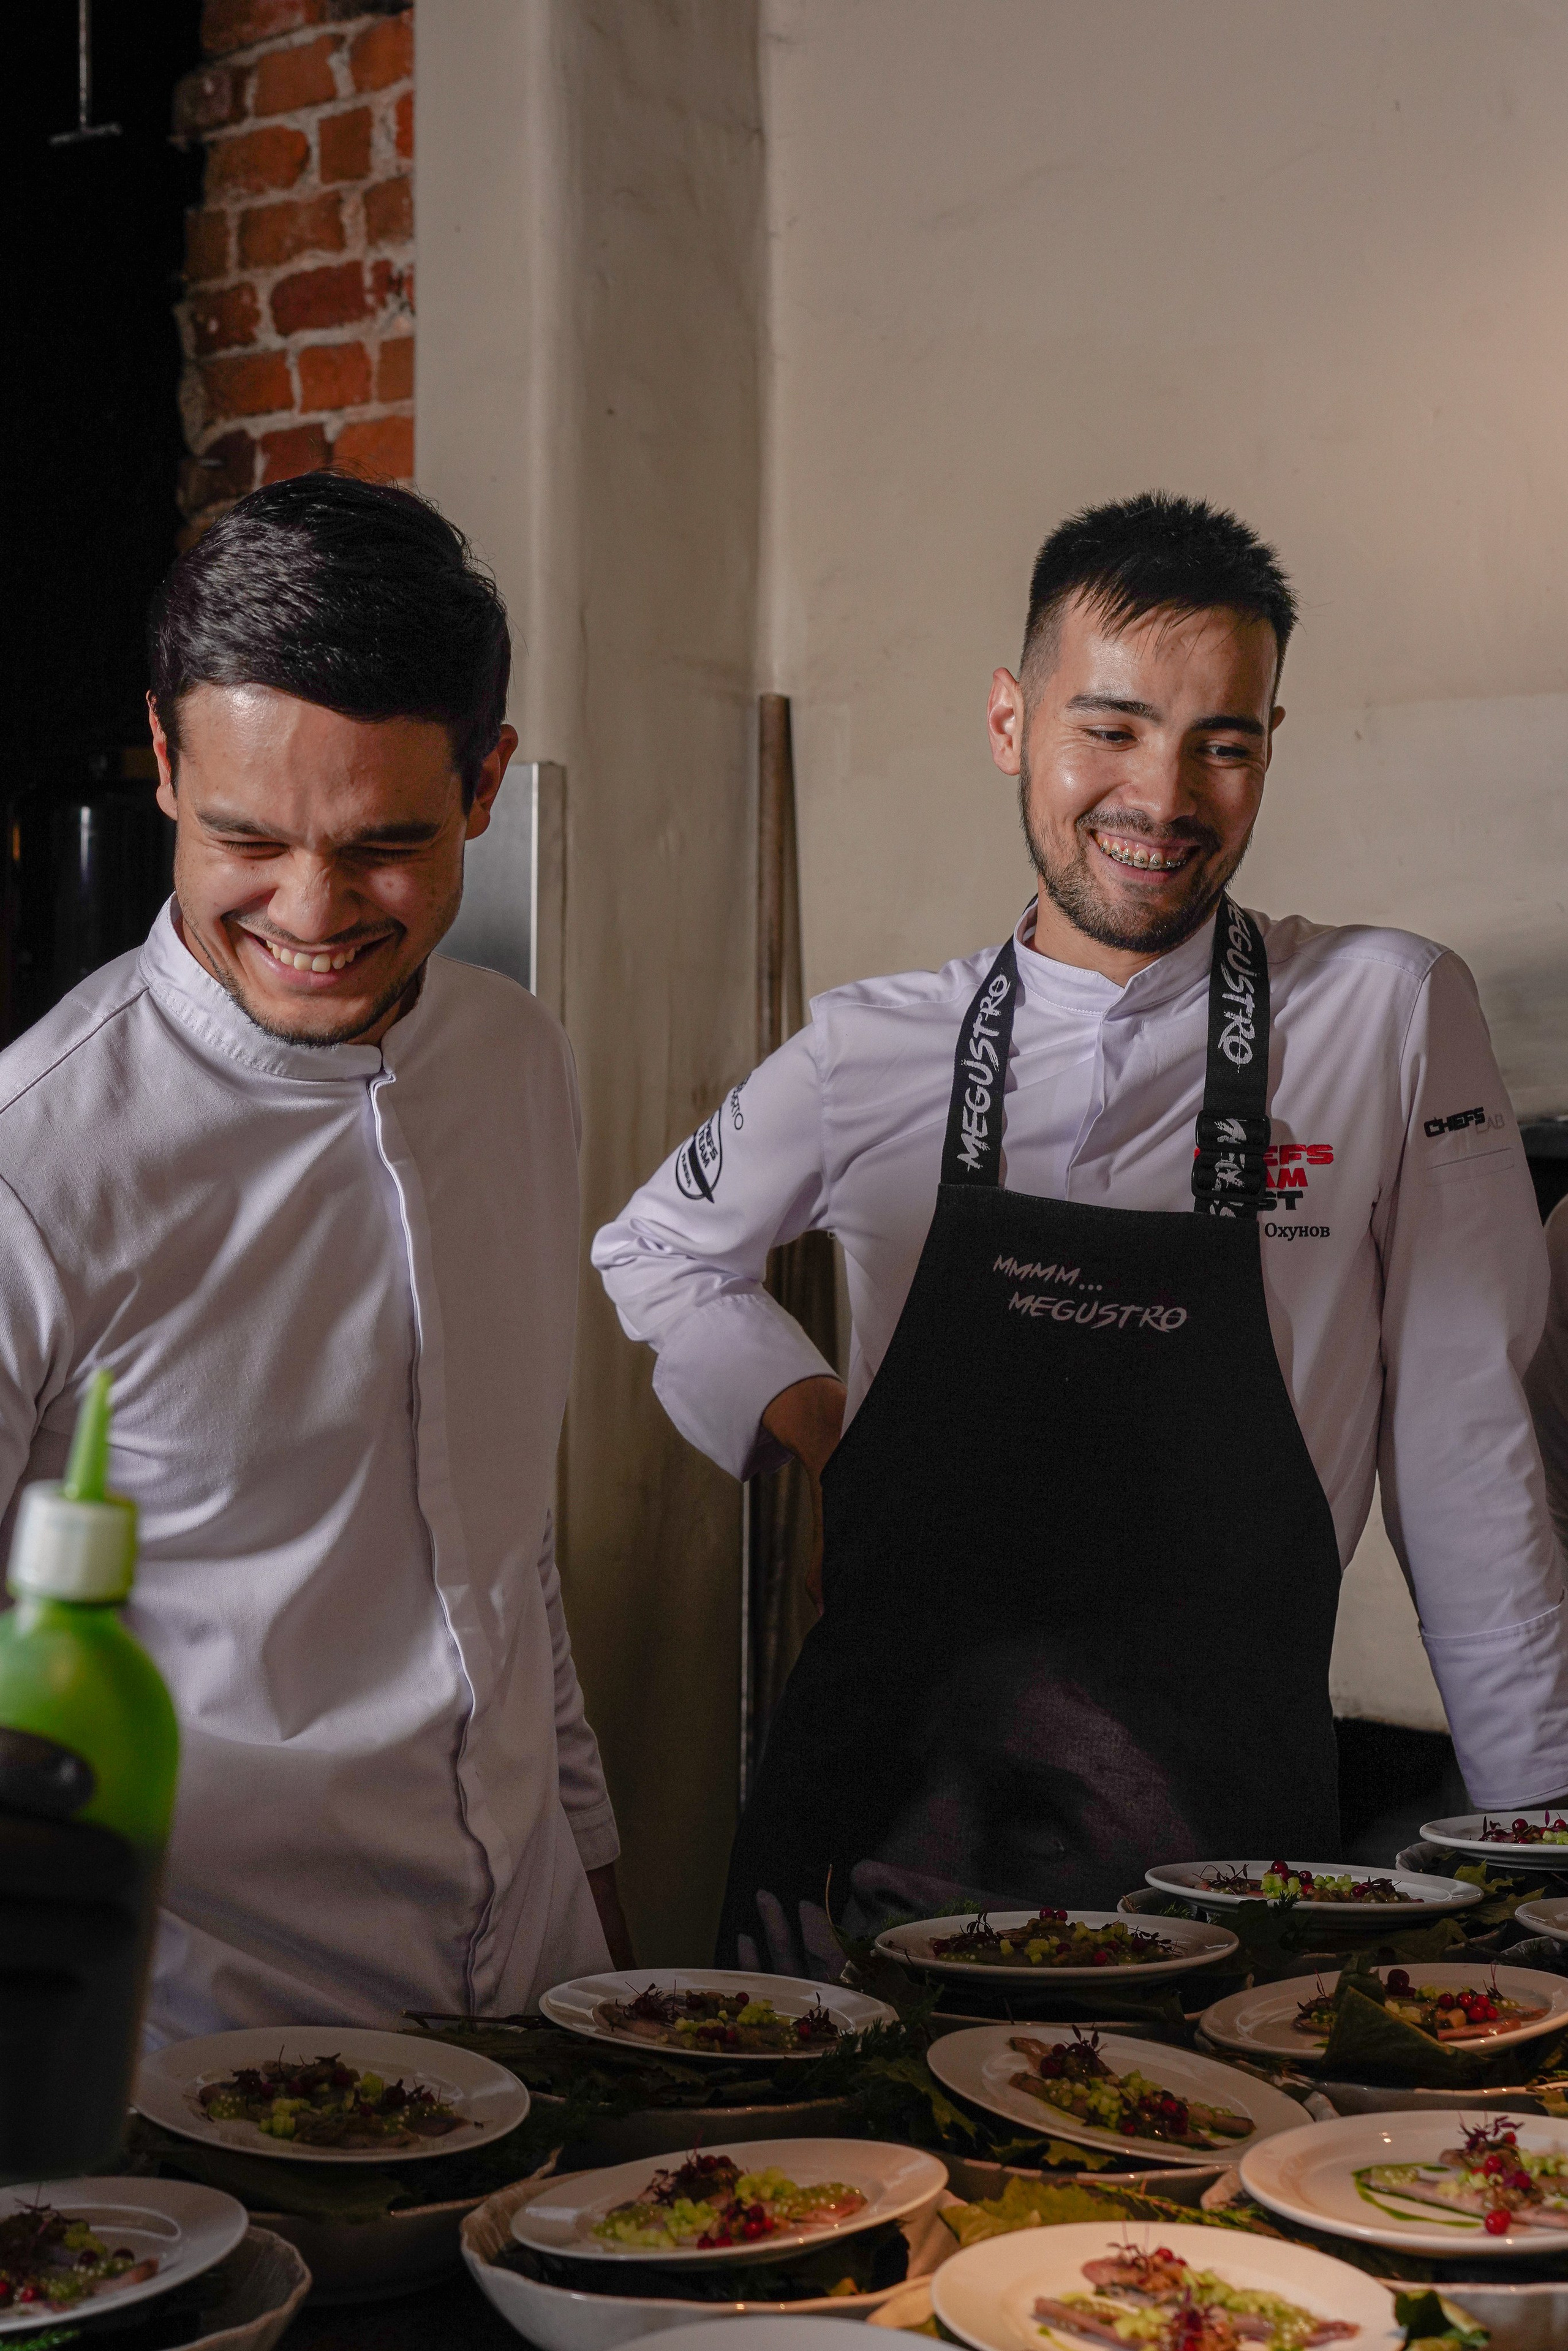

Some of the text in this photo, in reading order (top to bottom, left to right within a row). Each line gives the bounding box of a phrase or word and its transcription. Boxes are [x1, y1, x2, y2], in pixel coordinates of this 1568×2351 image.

[957, 974, 1011, 1172] MEGUSTRO
[1423, 1106, 1485, 1138] CHEFS
[1263, 1144, 1333, 1166] EFS
[1264, 1223, 1330, 1241] Охунов
[1008, 1291, 1188, 1333] MEGUSTRO
